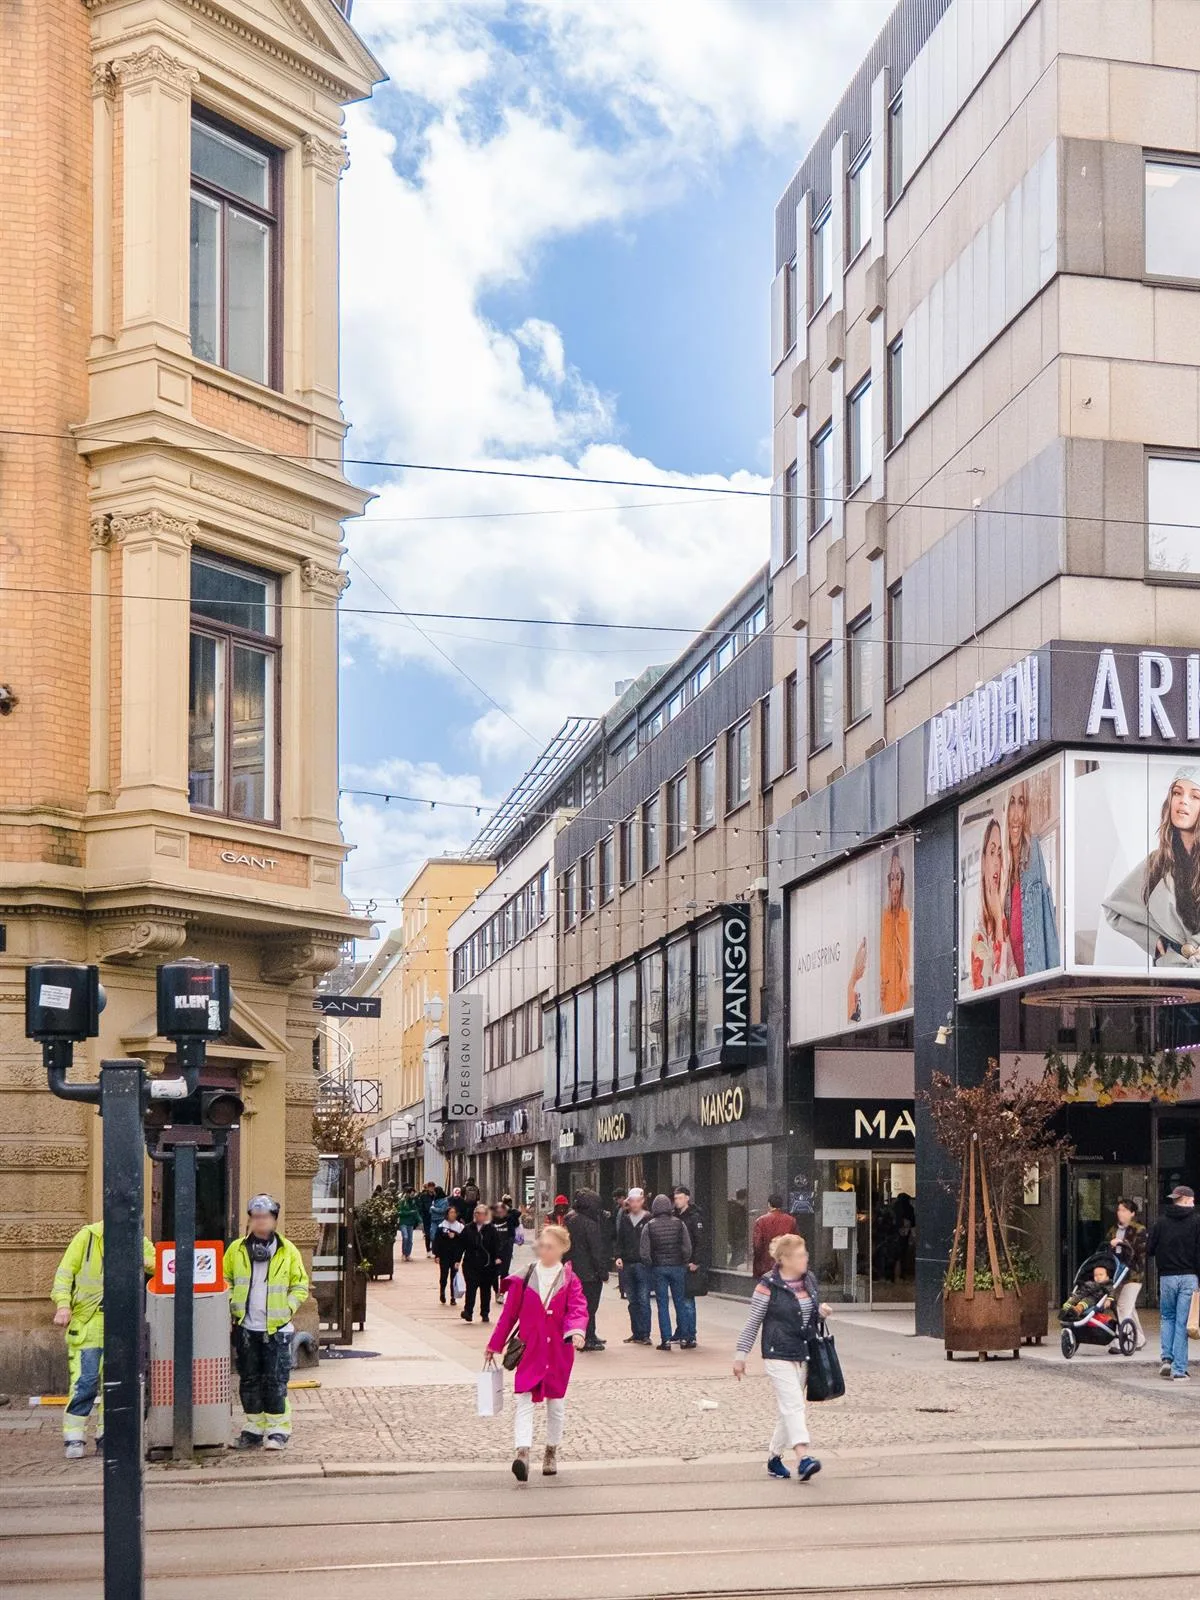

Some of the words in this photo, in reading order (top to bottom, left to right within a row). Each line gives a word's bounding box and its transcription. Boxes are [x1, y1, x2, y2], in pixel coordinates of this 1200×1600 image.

[926, 655, 1039, 796] ARKADEN
[220, 851, 278, 870] GANT
[725, 918, 747, 1046] MANGO
[461, 999, 471, 1036] ONLY
[461, 1043, 471, 1098] DESIGN
[701, 1086, 744, 1127] MANGO
[855, 1109, 916, 1139] MA
[597, 1113, 626, 1143] MANGO
